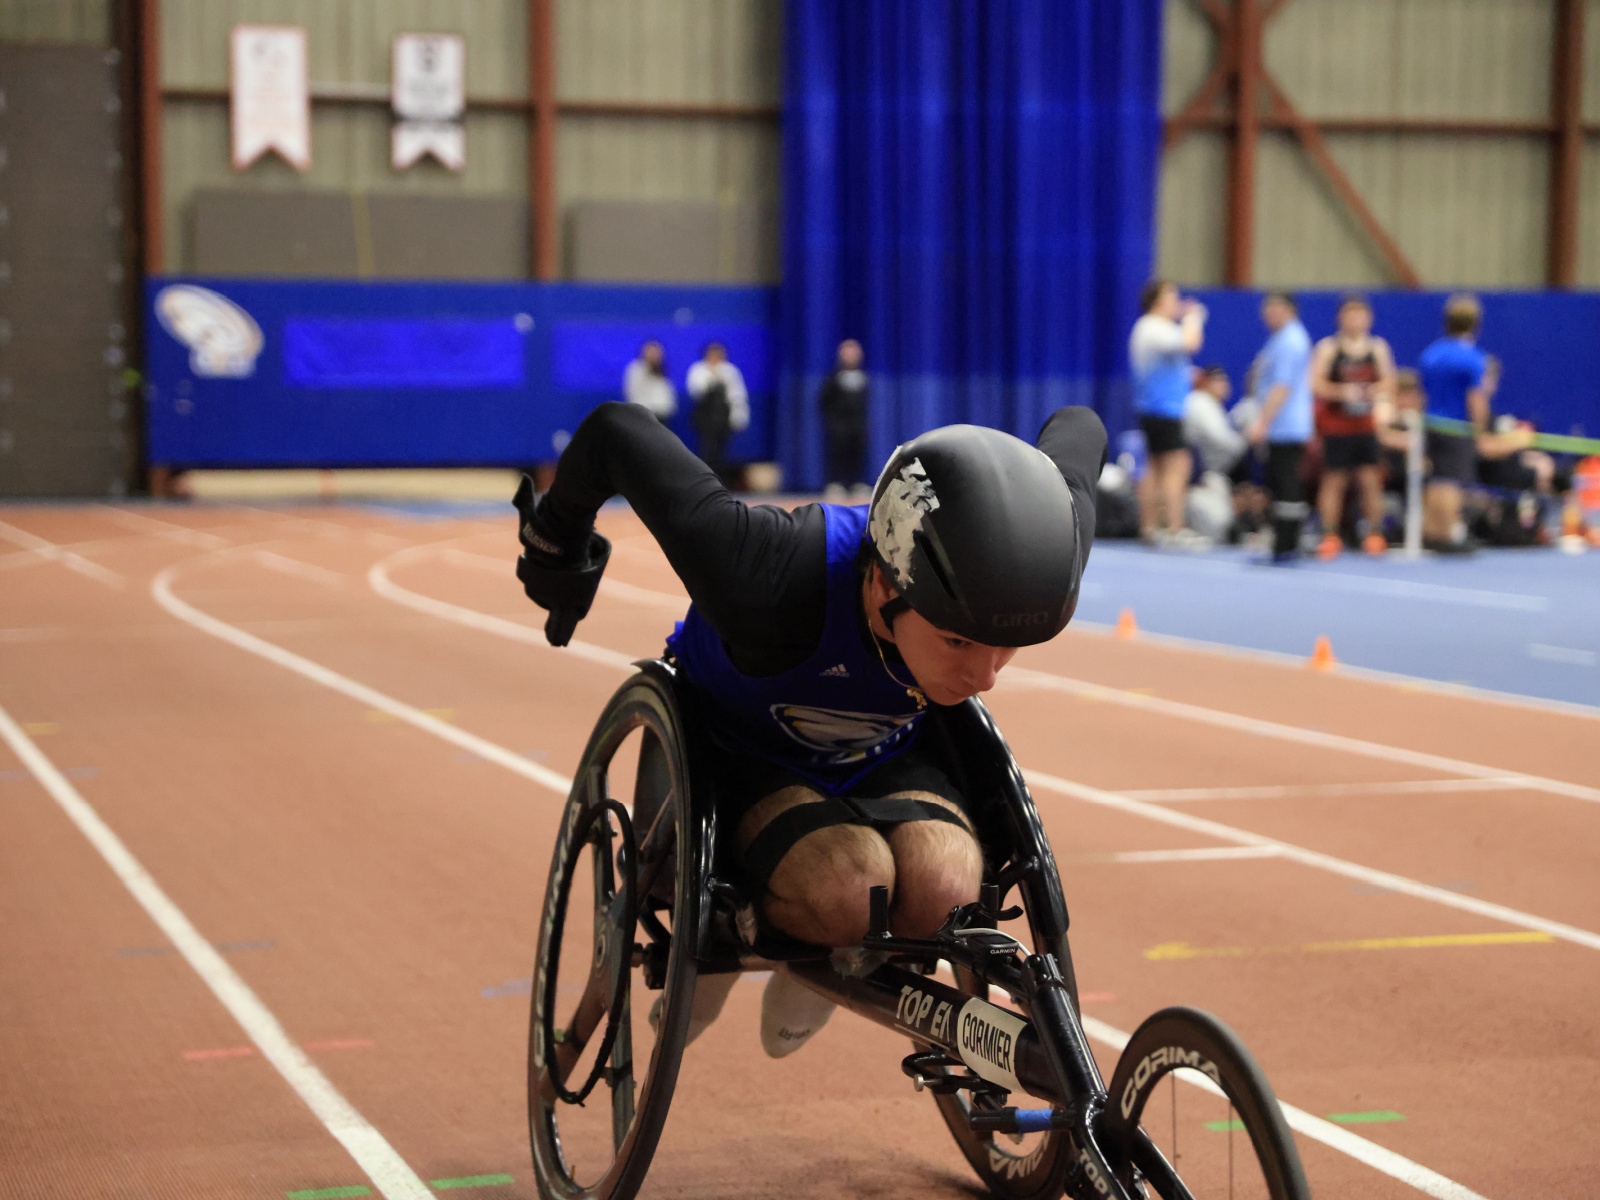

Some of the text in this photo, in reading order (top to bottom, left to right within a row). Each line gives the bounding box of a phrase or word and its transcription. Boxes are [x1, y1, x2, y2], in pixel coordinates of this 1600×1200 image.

[896, 985, 953, 1042] TOP EN
[963, 1012, 1012, 1073] CORMIER
[1121, 1047, 1221, 1120] CORIMA
[1079, 1147, 1108, 1195] TOP
